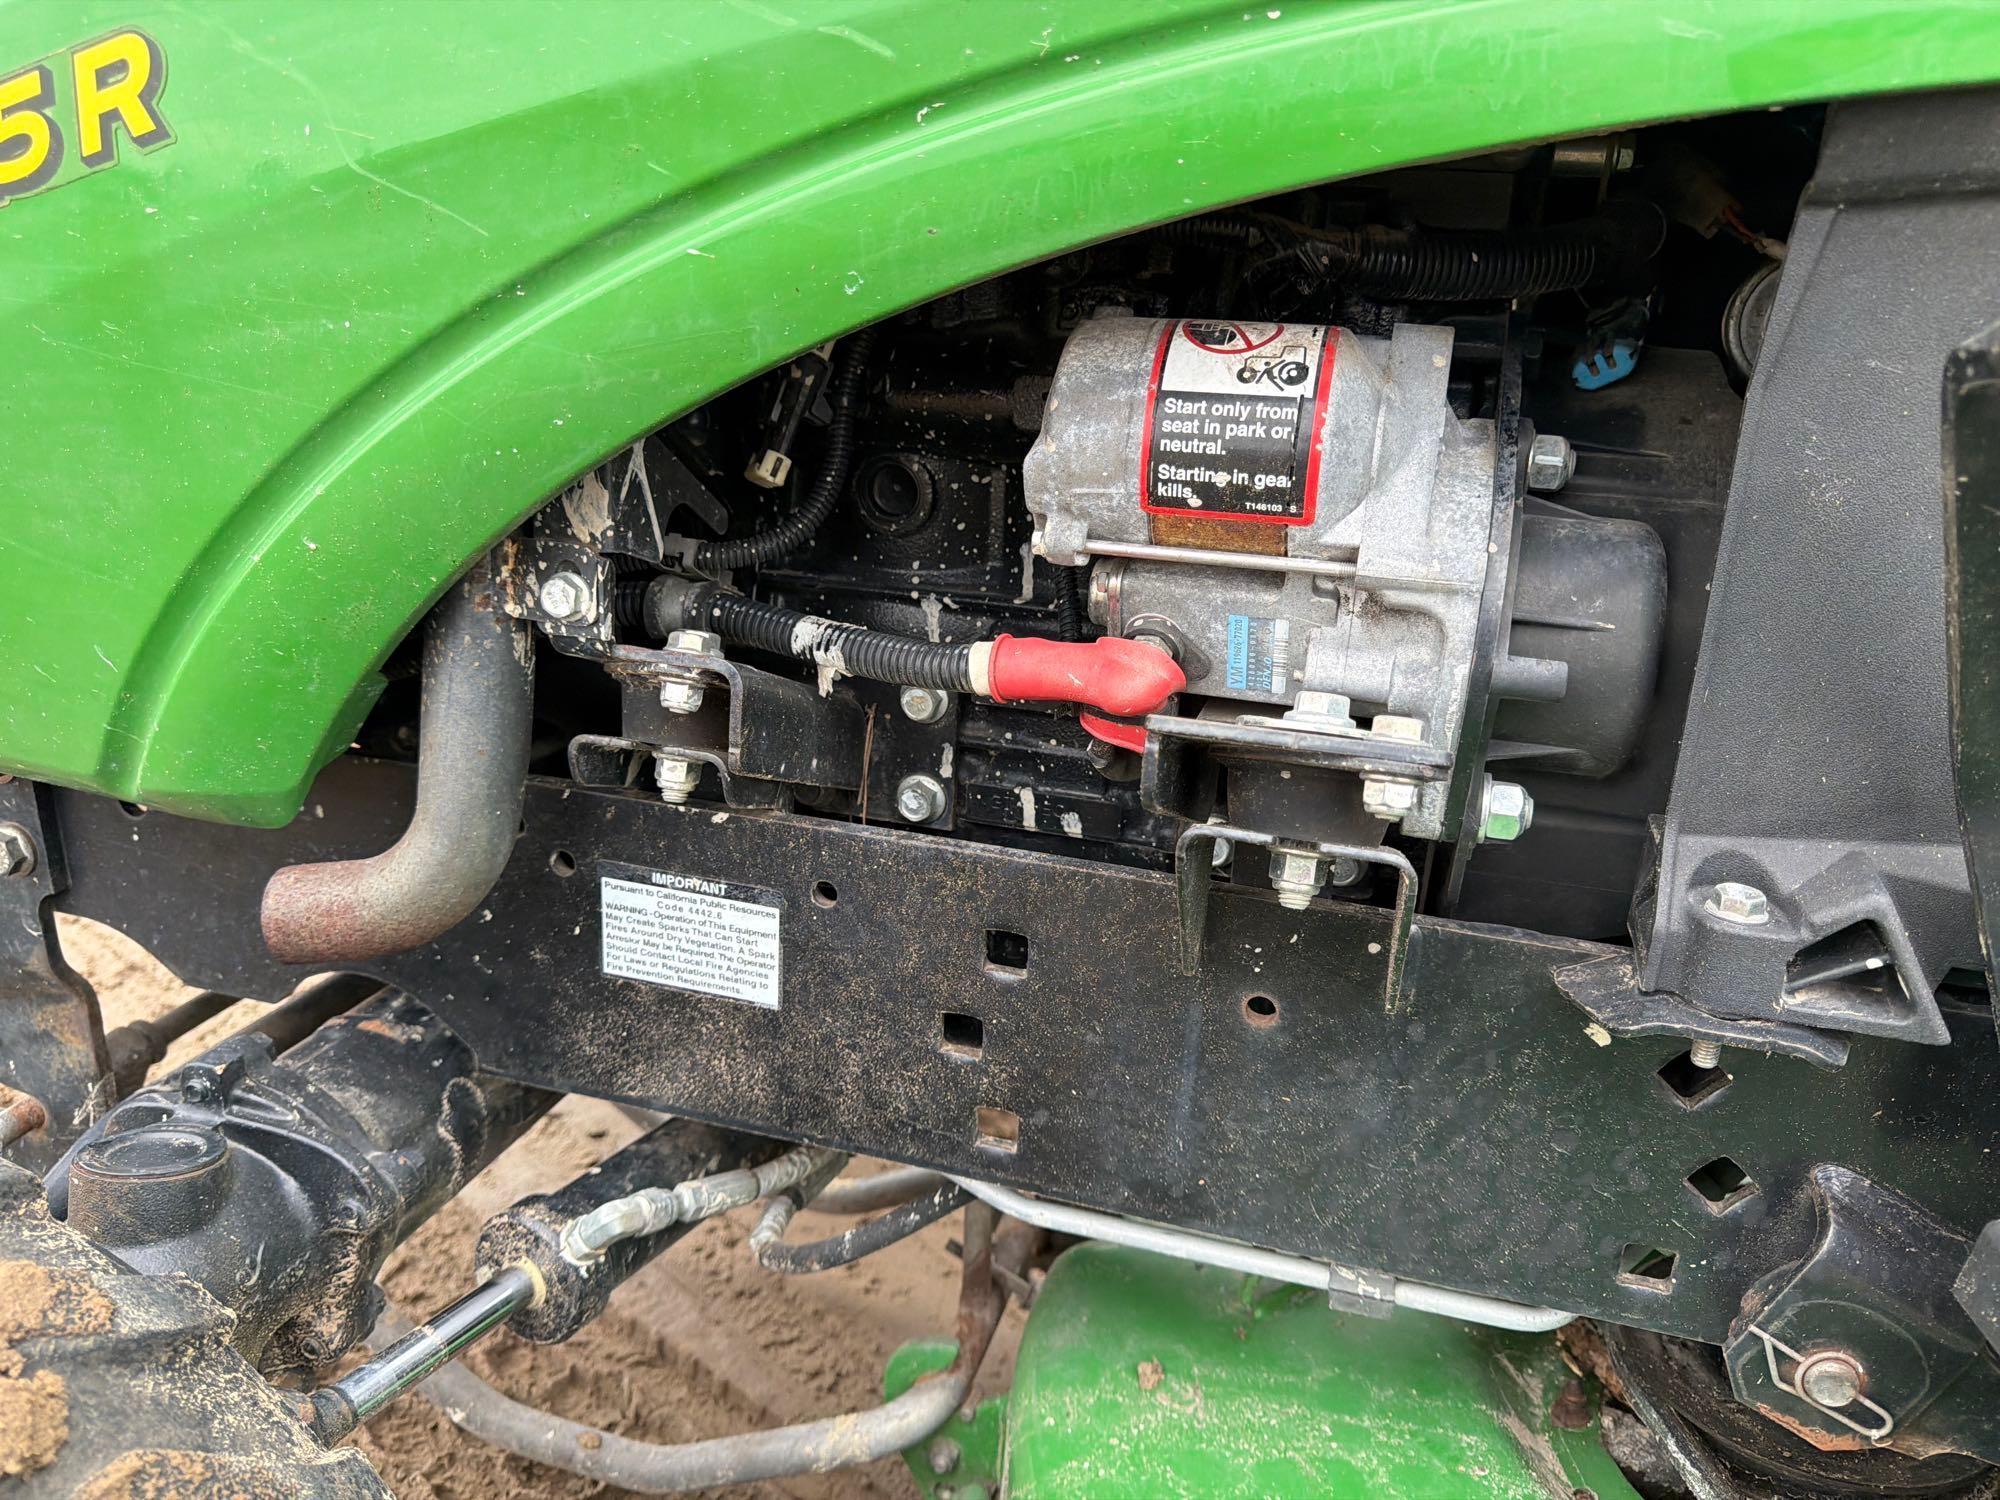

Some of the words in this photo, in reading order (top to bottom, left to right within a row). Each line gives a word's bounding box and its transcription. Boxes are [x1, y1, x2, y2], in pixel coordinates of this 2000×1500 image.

[1164, 397, 1207, 415] Start
[1211, 402, 1250, 420] only
[1255, 402, 1297, 420] from
[1161, 419, 1199, 434] seat
[1204, 419, 1220, 435] in
[1225, 421, 1266, 439] park
[1271, 426, 1291, 439] or
[1160, 438, 1226, 455] neutral.
[1157, 482, 1197, 499] kills.
[1233, 469, 1248, 485] in
[1254, 474, 1292, 490] gear
[1290, 505, 1297, 513] S
[1230, 666, 1243, 684] YM
[652, 872, 728, 896] IMPORTANT
[604, 880, 644, 895] Pursuant
[645, 888, 655, 897] to
[656, 890, 697, 905] California
[700, 898, 727, 910] Public
[729, 903, 777, 919] Resources
[657, 900, 684, 912] Code
[605, 901, 648, 916] WARNING
[698, 919, 707, 927] of
[708, 920, 726, 931] This
[729, 924, 777, 940] Equipment
[605, 912, 623, 923] May
[626, 915, 656, 928] Create
[658, 921, 690, 934] Sparks
[692, 927, 712, 938] That
[714, 932, 733, 942] Can
[736, 935, 758, 947] Start
[605, 921, 628, 933] Fires
[631, 927, 664, 939] Around
[666, 932, 682, 944] Dry
[685, 936, 736, 953] Vegetation.
[738, 946, 745, 955] A
[748, 948, 776, 960] Spark
[606, 942, 638, 954] Should
[640, 948, 675, 961] Contact
[678, 955, 703, 967] Local
[705, 960, 723, 970] Fire
[726, 965, 769, 979] Agencies
[643, 938, 660, 950] May
[662, 943, 673, 951] be
[675, 944, 717, 959] Required.
[718, 952, 734, 963] The
[736, 956, 776, 971] Operator
[606, 952, 621, 960] For
[624, 955, 647, 966] Laws
[661, 962, 716, 979] Regulations
[719, 973, 757, 989] Relating
[759, 980, 769, 990] to
[606, 961, 624, 971] Fire
[626, 965, 674, 981] Prevention
[677, 975, 743, 994] Requirements.
